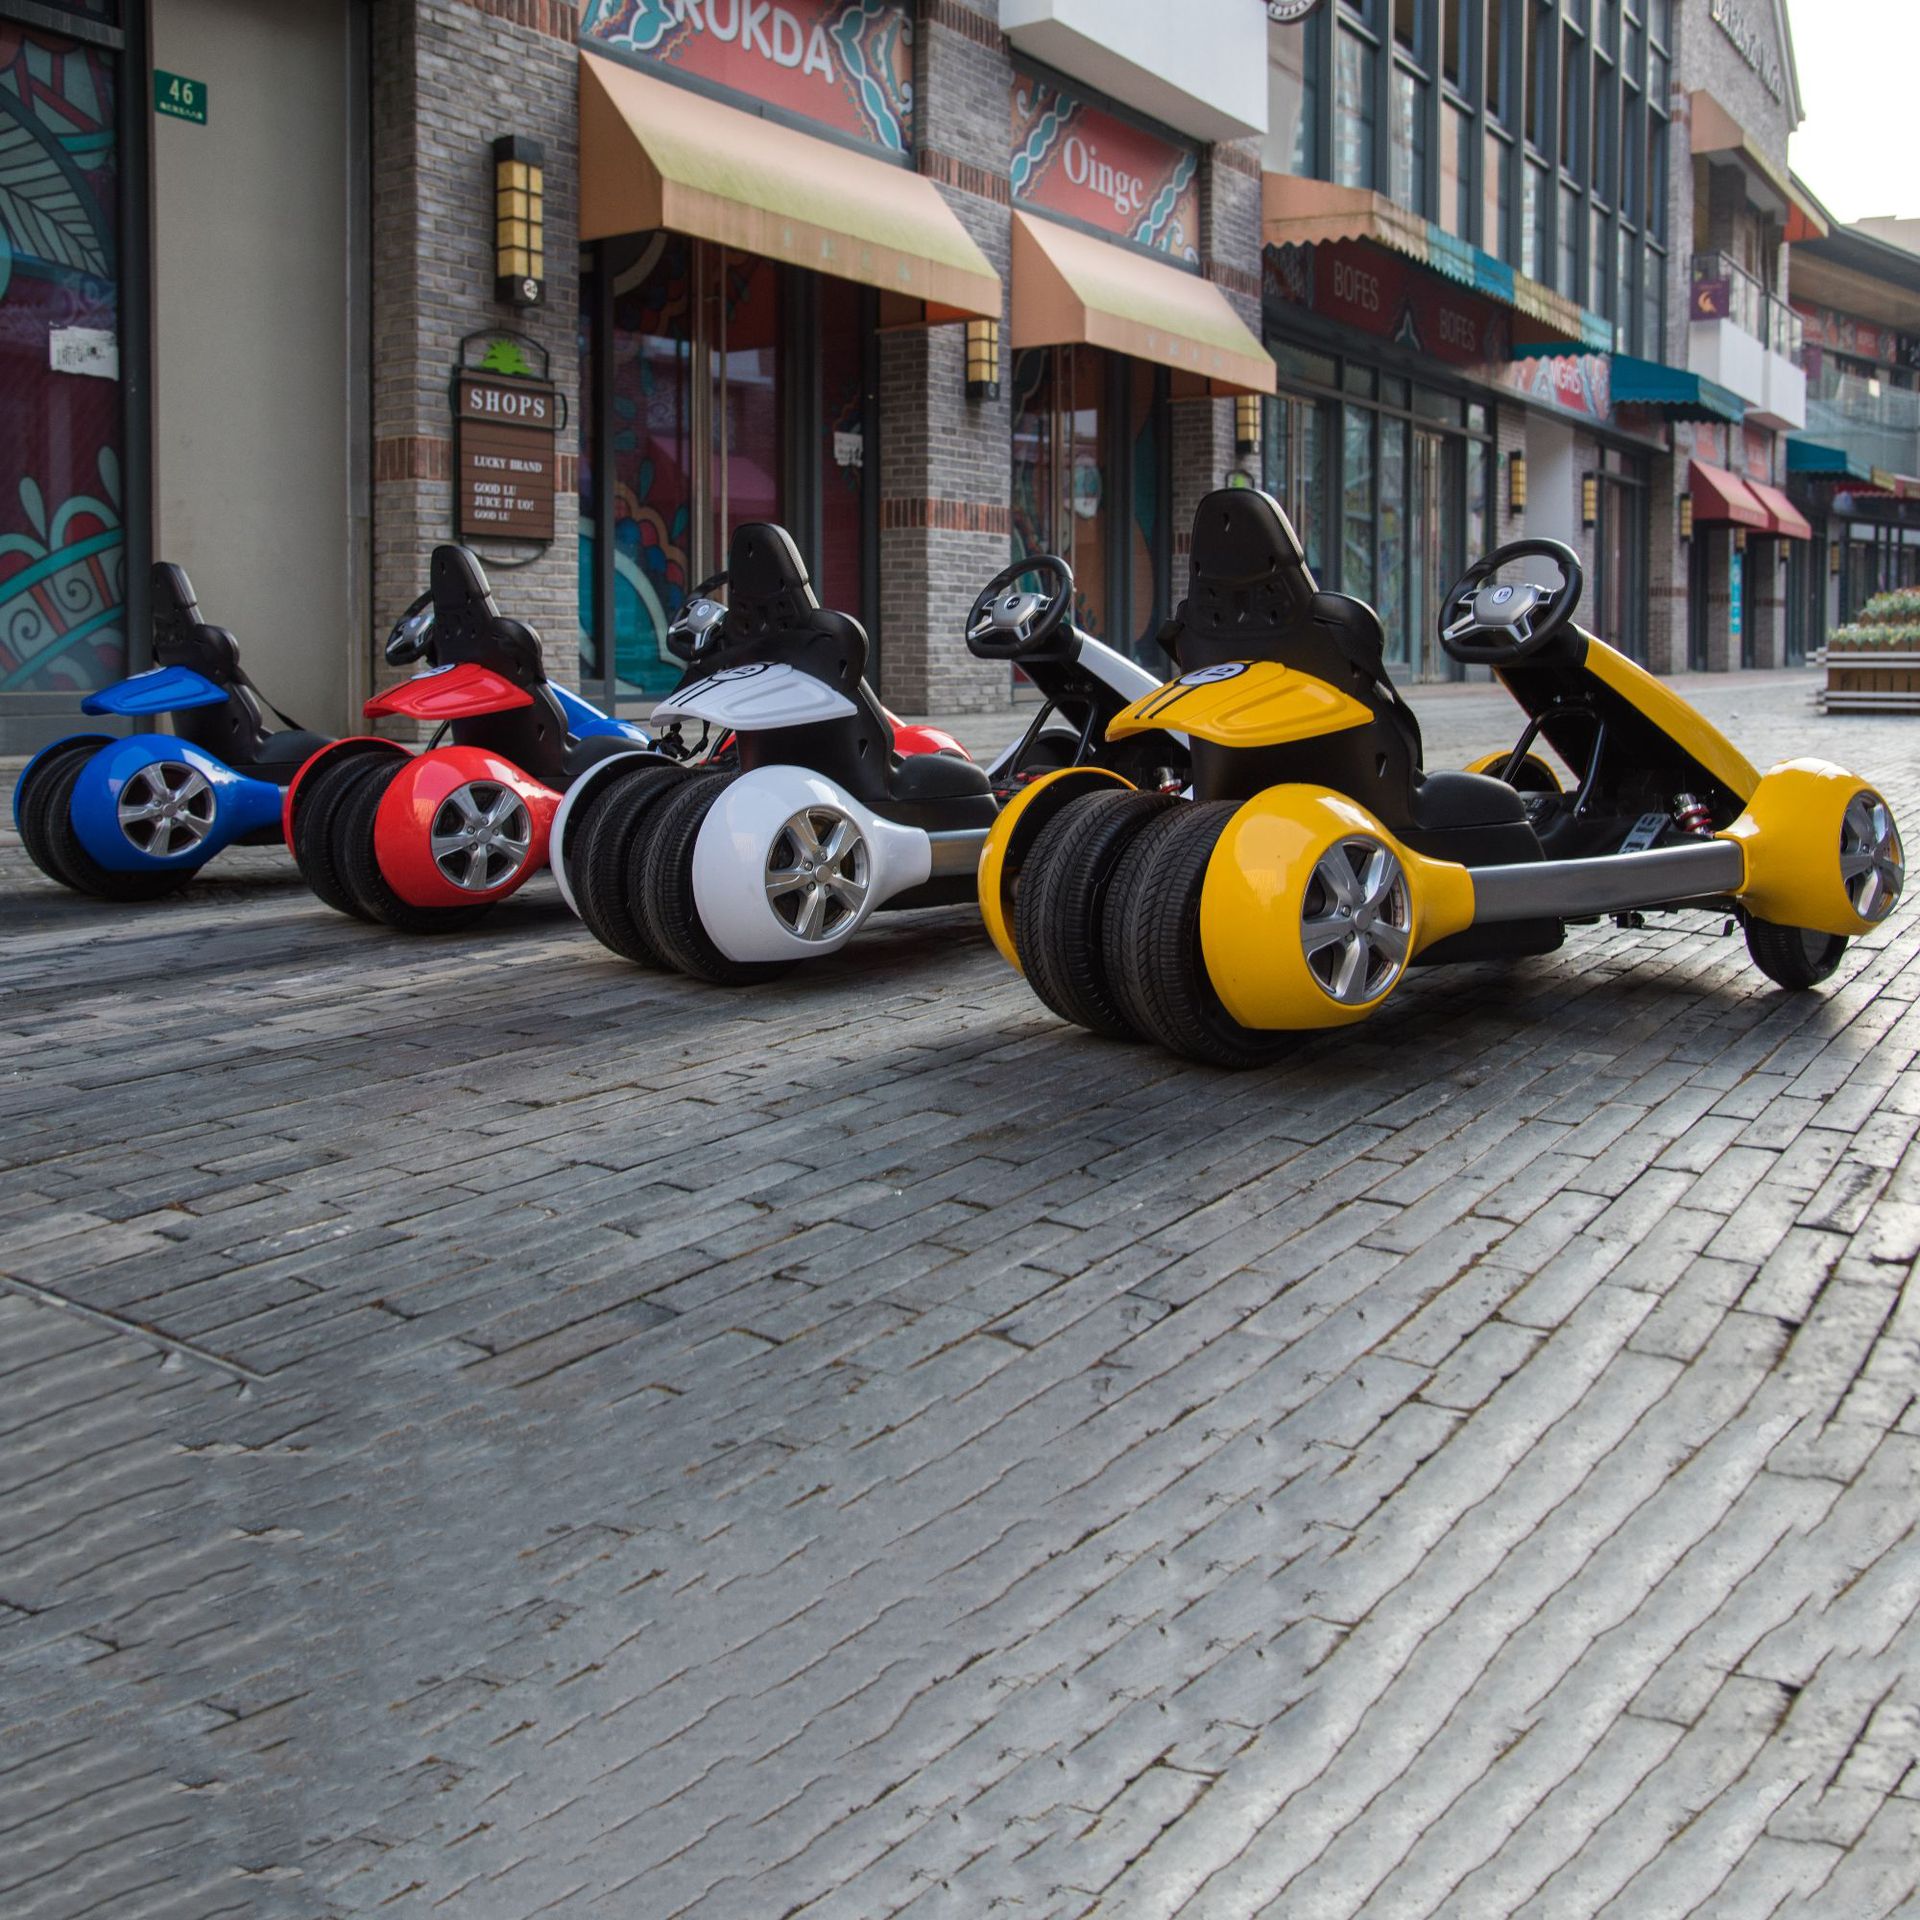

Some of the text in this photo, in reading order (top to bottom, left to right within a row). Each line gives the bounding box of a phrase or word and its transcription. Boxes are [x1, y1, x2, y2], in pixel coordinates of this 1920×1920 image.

[169, 79, 194, 105] 46
[1333, 260, 1380, 312] BOFES
[471, 389, 545, 418] SHOPS
[474, 455, 543, 473] LUCKY BRAND
[474, 482, 501, 495] GOOD
[474, 496, 502, 508] JUICE
[504, 498, 515, 510] IT
